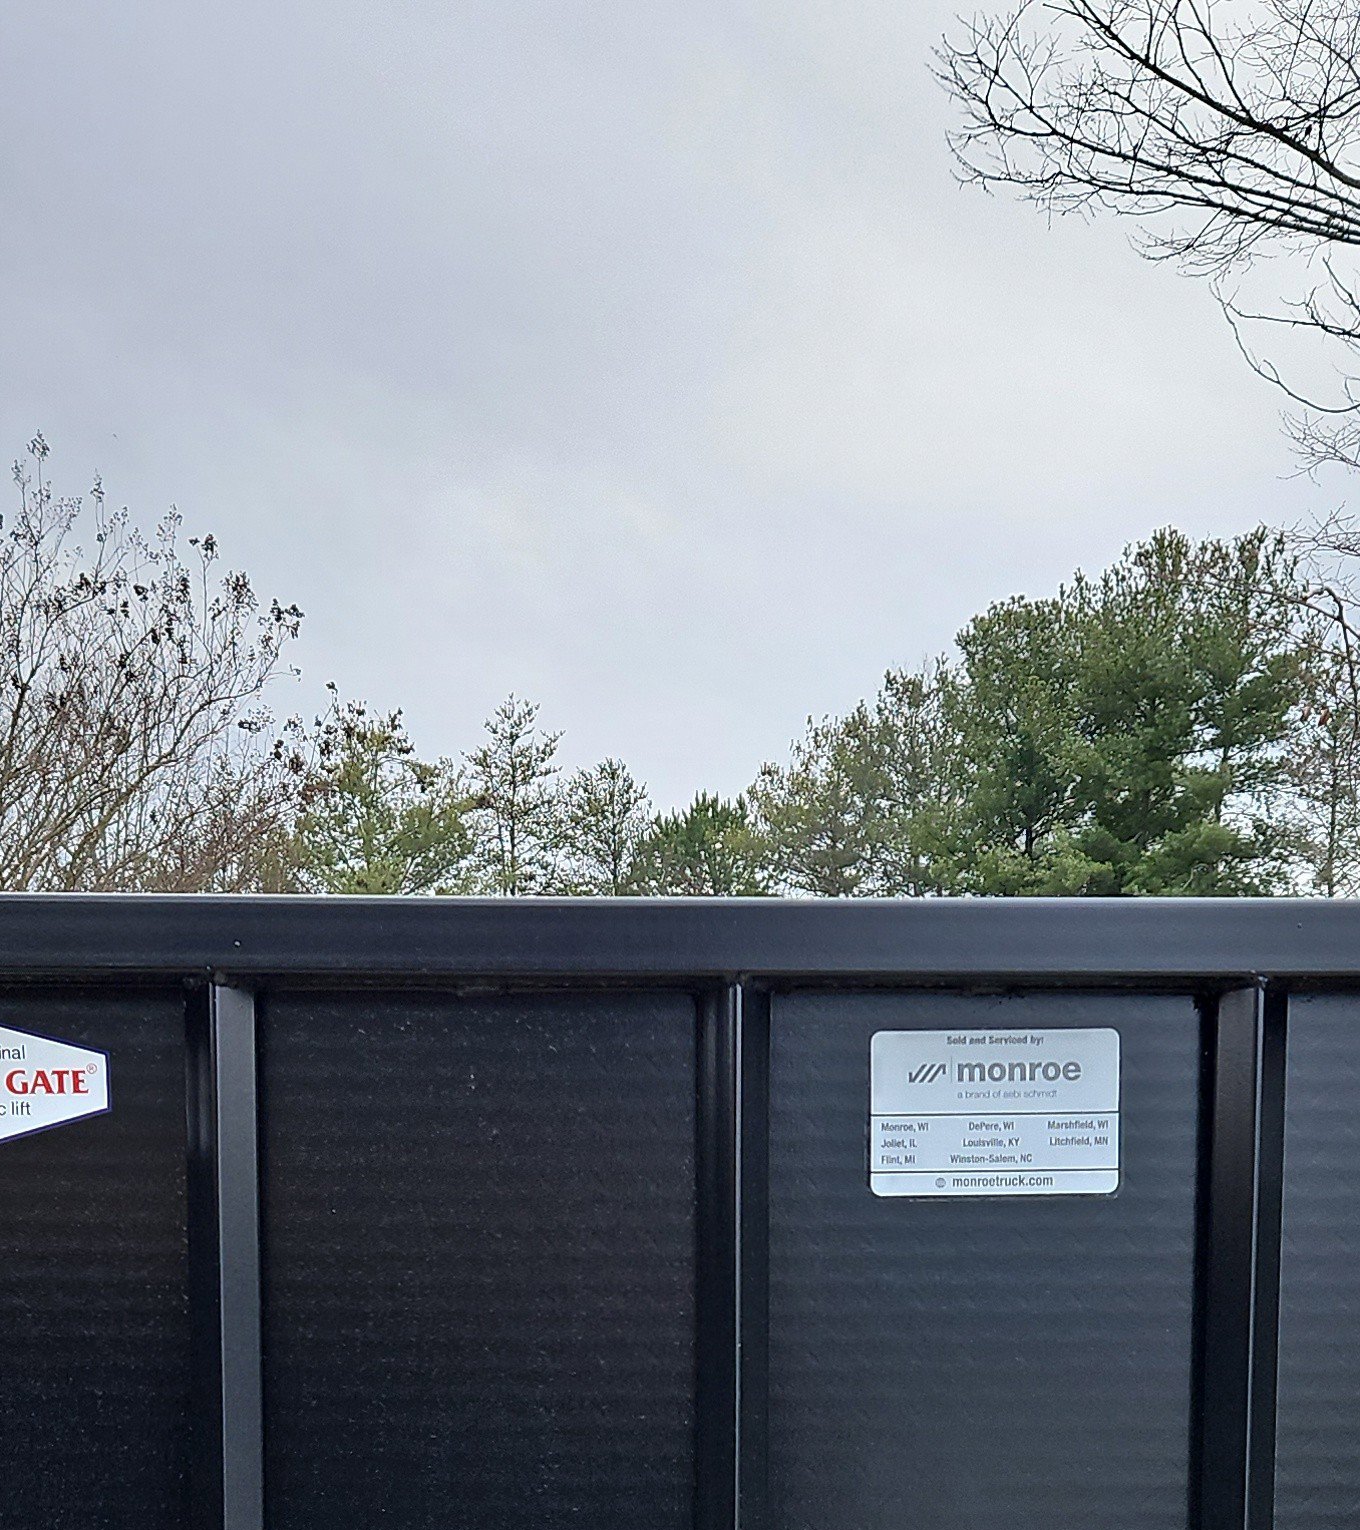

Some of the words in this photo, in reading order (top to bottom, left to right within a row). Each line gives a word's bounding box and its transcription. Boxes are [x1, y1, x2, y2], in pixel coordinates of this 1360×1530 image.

[946, 1036, 966, 1045] Sold
[969, 1036, 986, 1045] and
[989, 1035, 1027, 1044] Serviced
[1030, 1035, 1044, 1046] by:
[957, 1061, 1081, 1082] monroe
[957, 1091, 963, 1099] a
[965, 1090, 990, 1099] brand
[992, 1089, 1001, 1098] of
[11, 1101, 31, 1116] lift
[881, 1122, 917, 1133] Monroe,
[917, 1122, 929, 1131] WI
[968, 1121, 1001, 1131] DePere,
[1003, 1121, 1014, 1130] WI
[1047, 1120, 1096, 1130] Marshfield,
[1097, 1120, 1109, 1129] WI
[881, 1139, 907, 1148] Joliet,
[909, 1139, 917, 1148] IL
[963, 1138, 1006, 1148] Louisville,
[1008, 1137, 1020, 1146] KY
[1049, 1136, 1092, 1147] Litchfield,
[1094, 1136, 1109, 1145] MN
[881, 1155, 903, 1165] Flint,
[905, 1155, 916, 1164] MI
[950, 1154, 1018, 1164] Winston-Salem,
[1020, 1154, 1032, 1163] NC
[952, 1175, 1053, 1187] monroetruck.com
